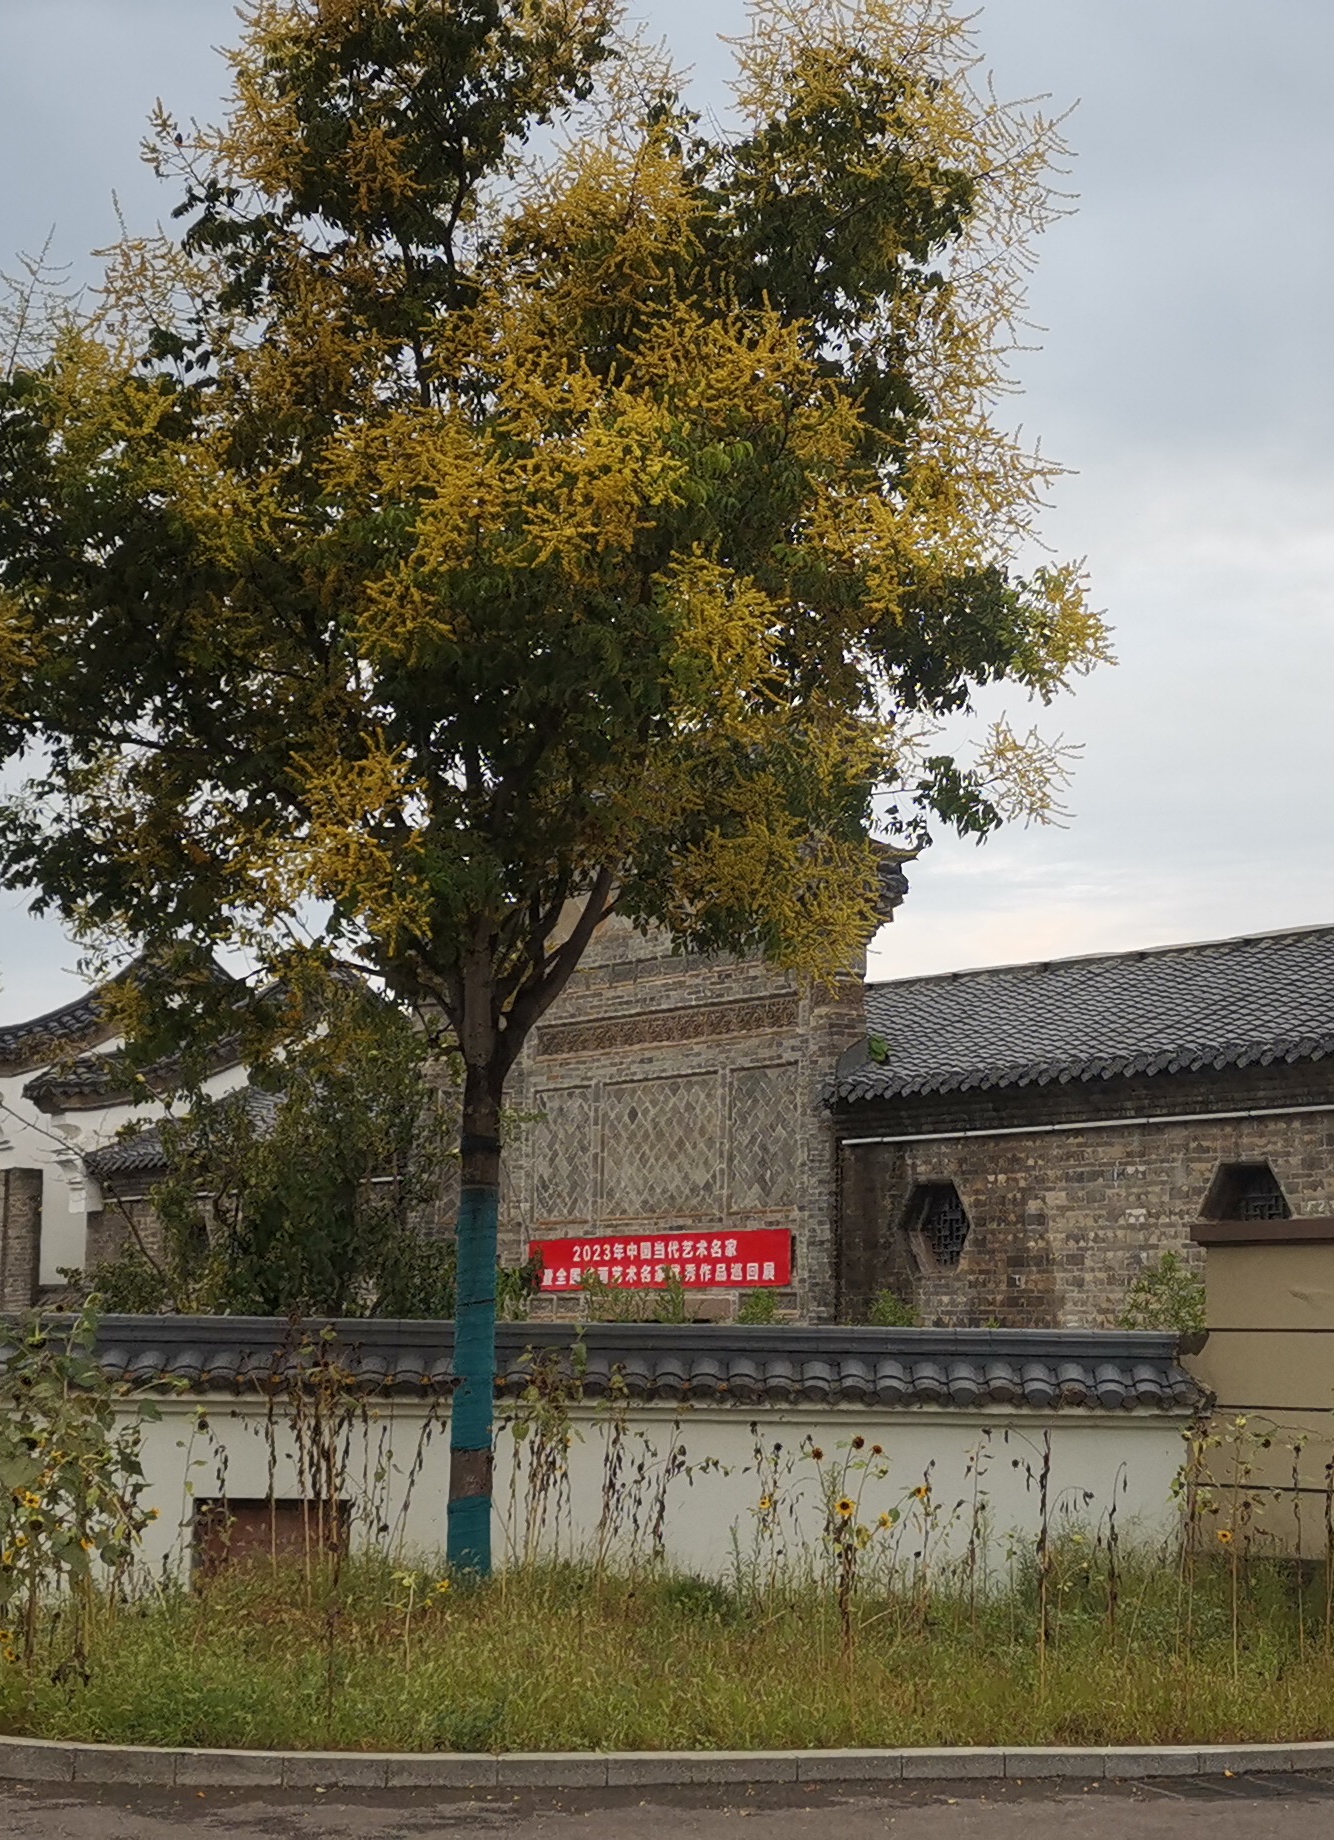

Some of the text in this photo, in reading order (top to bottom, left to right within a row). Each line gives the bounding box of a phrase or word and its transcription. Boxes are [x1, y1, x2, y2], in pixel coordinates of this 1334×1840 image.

[572, 1238, 738, 1262] 2023年中国当代艺术名家
